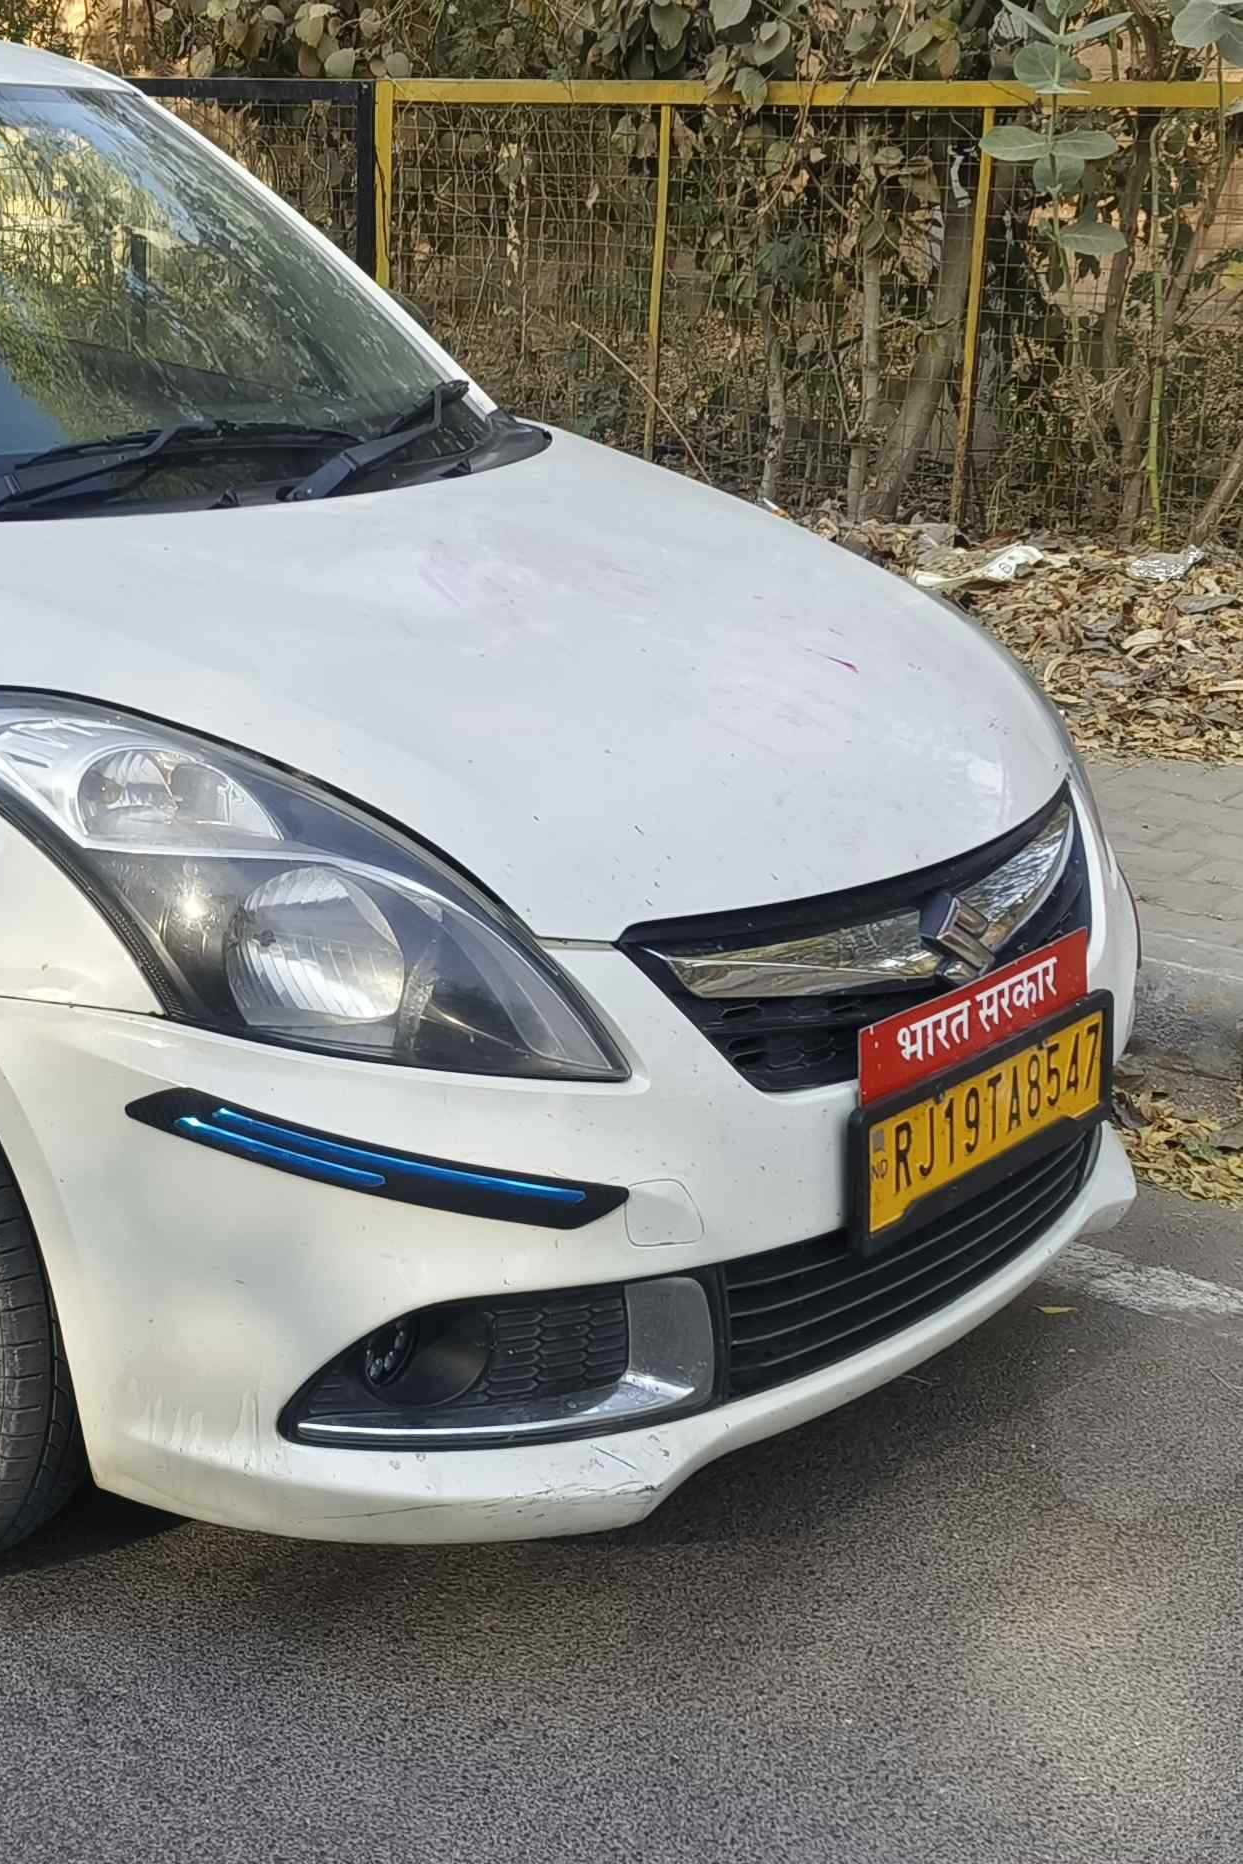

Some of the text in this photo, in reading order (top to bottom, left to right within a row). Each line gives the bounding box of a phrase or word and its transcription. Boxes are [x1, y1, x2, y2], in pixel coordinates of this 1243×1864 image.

[897, 957, 1057, 1061] भारत सरकार
[894, 1023, 1099, 1193] RJ19TA8547
